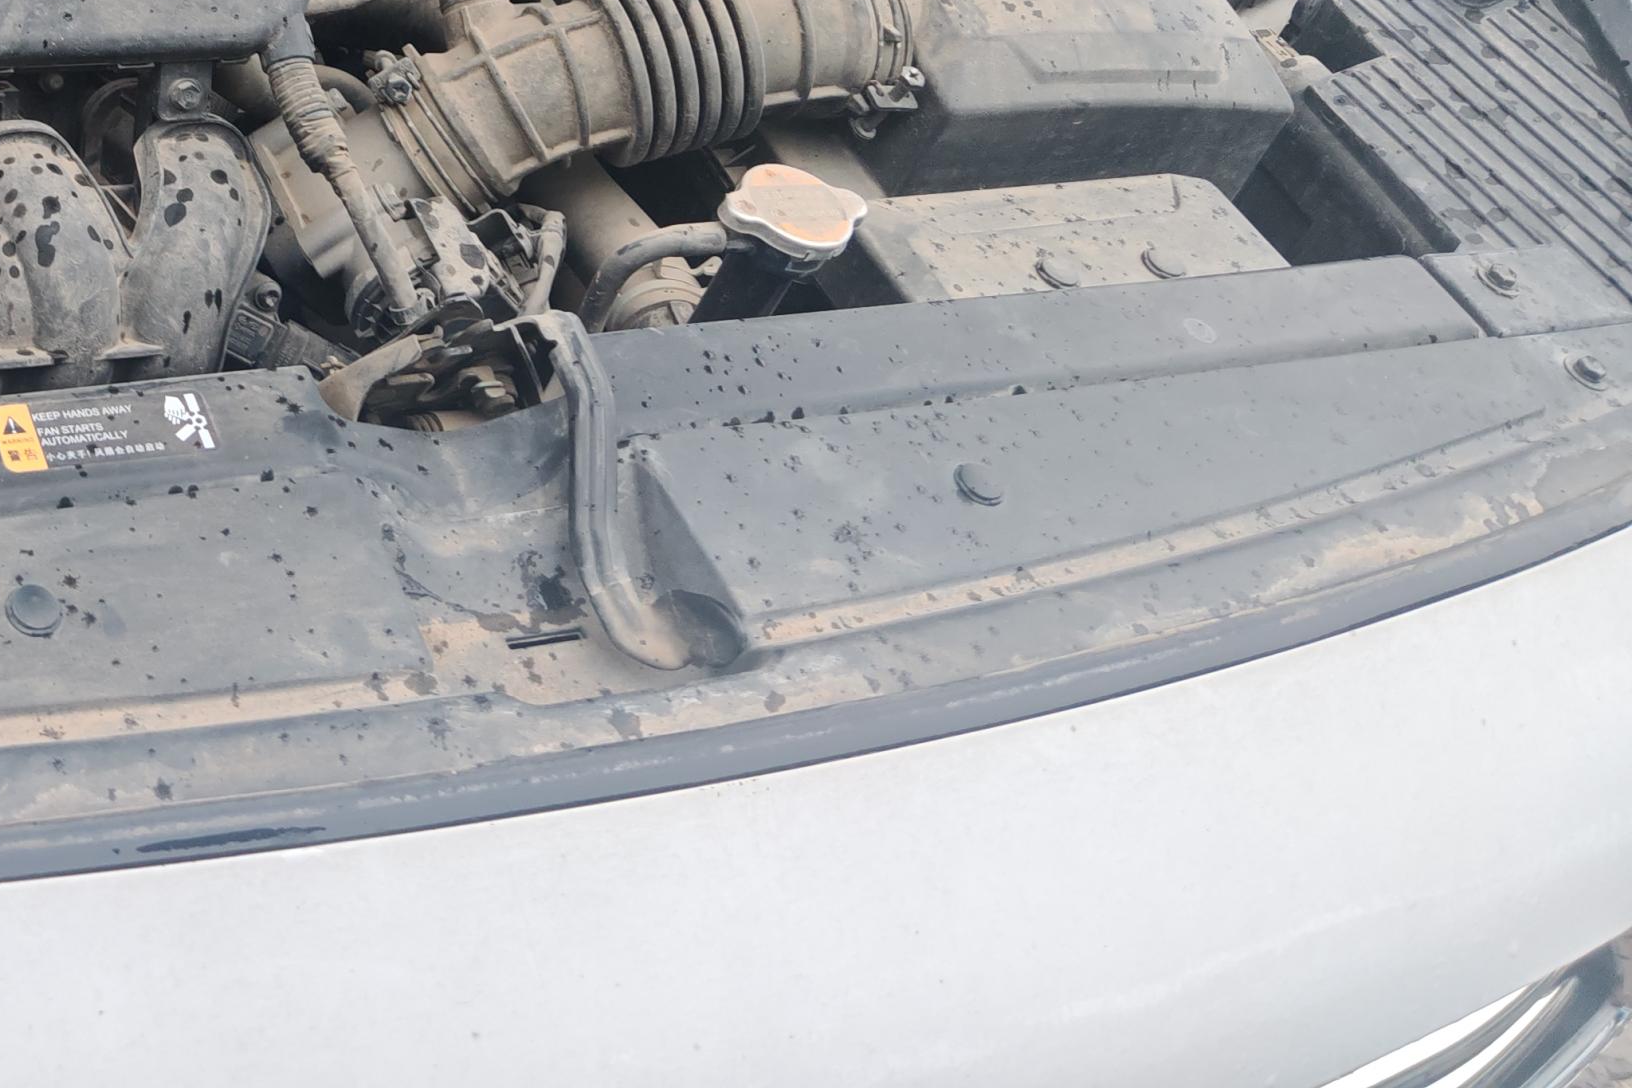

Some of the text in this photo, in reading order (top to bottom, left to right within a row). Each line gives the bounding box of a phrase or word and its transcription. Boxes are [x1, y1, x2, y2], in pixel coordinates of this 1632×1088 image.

[32, 404, 132, 422] KEEP HANDS AWAY
[37, 422, 104, 436] FAN STARTS
[41, 430, 128, 446] AUTOMATICALLY
